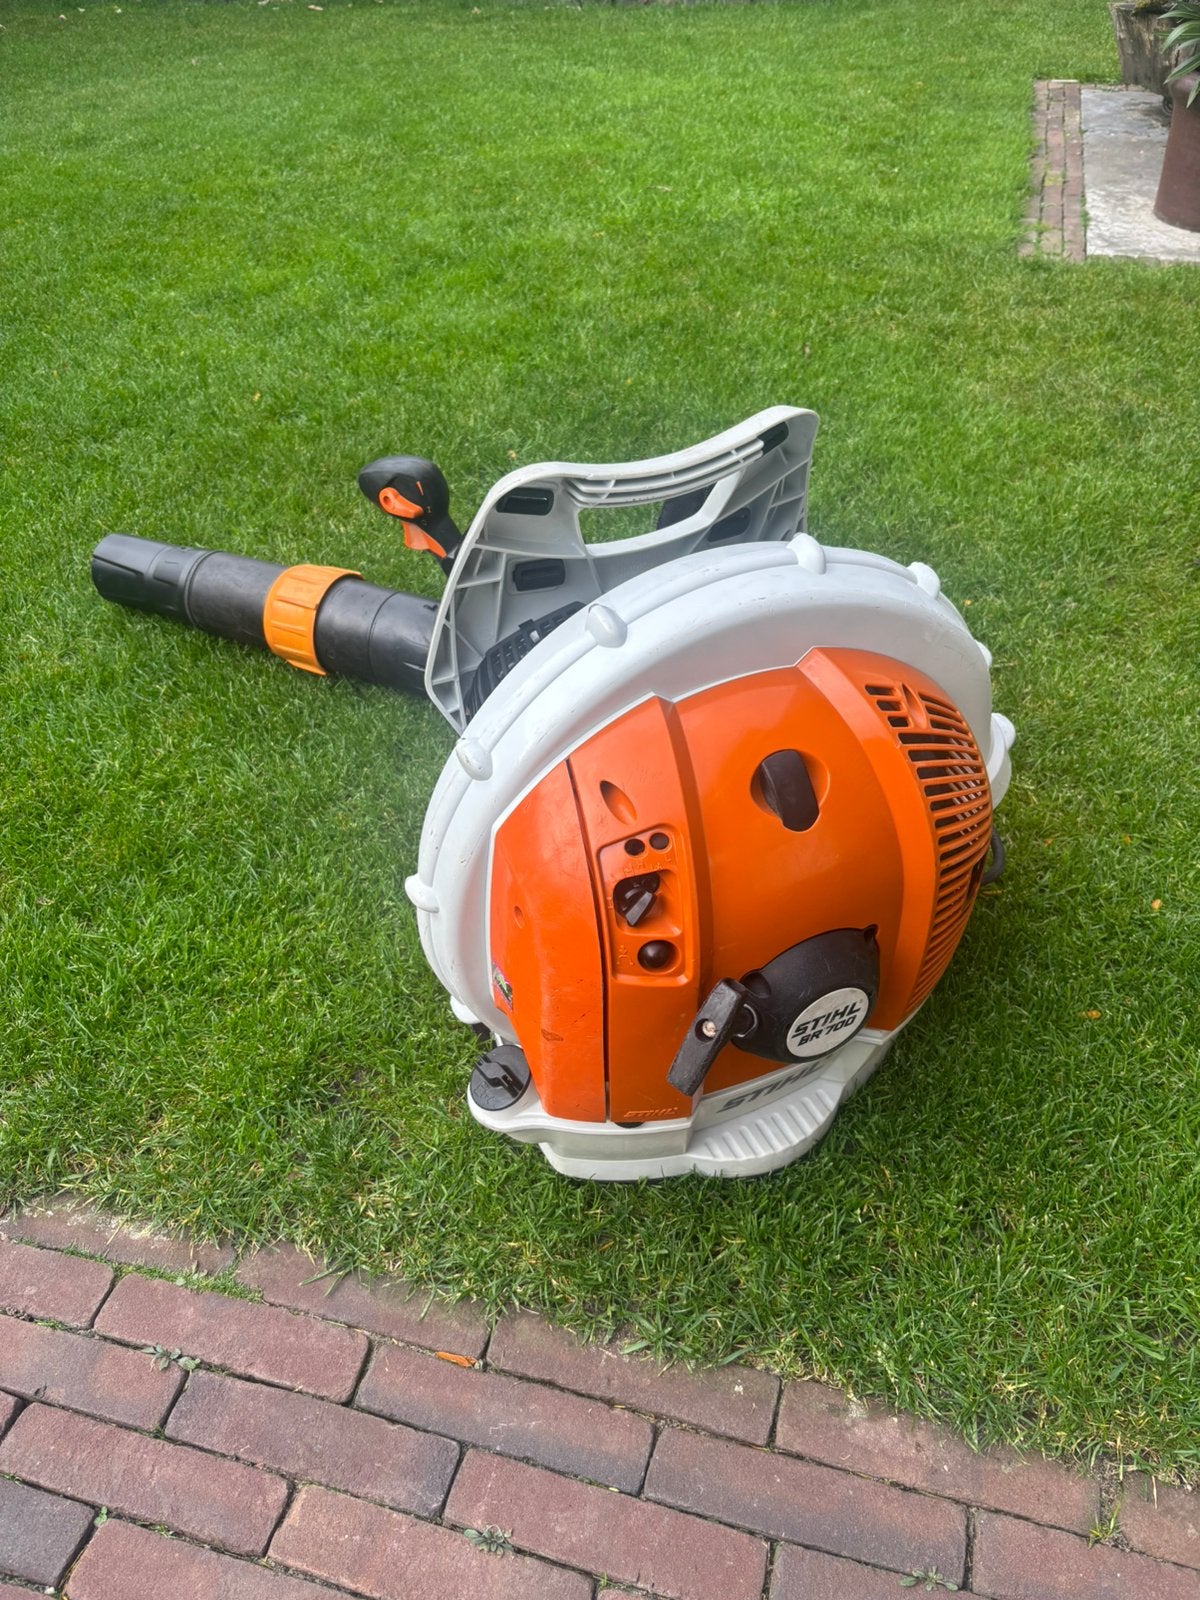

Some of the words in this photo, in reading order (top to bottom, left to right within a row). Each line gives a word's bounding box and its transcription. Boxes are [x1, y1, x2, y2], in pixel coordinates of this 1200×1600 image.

[791, 1001, 862, 1039] STIHL
[797, 1030, 822, 1047] BR
[825, 1014, 857, 1036] 700
[716, 1061, 822, 1114] STIHL
